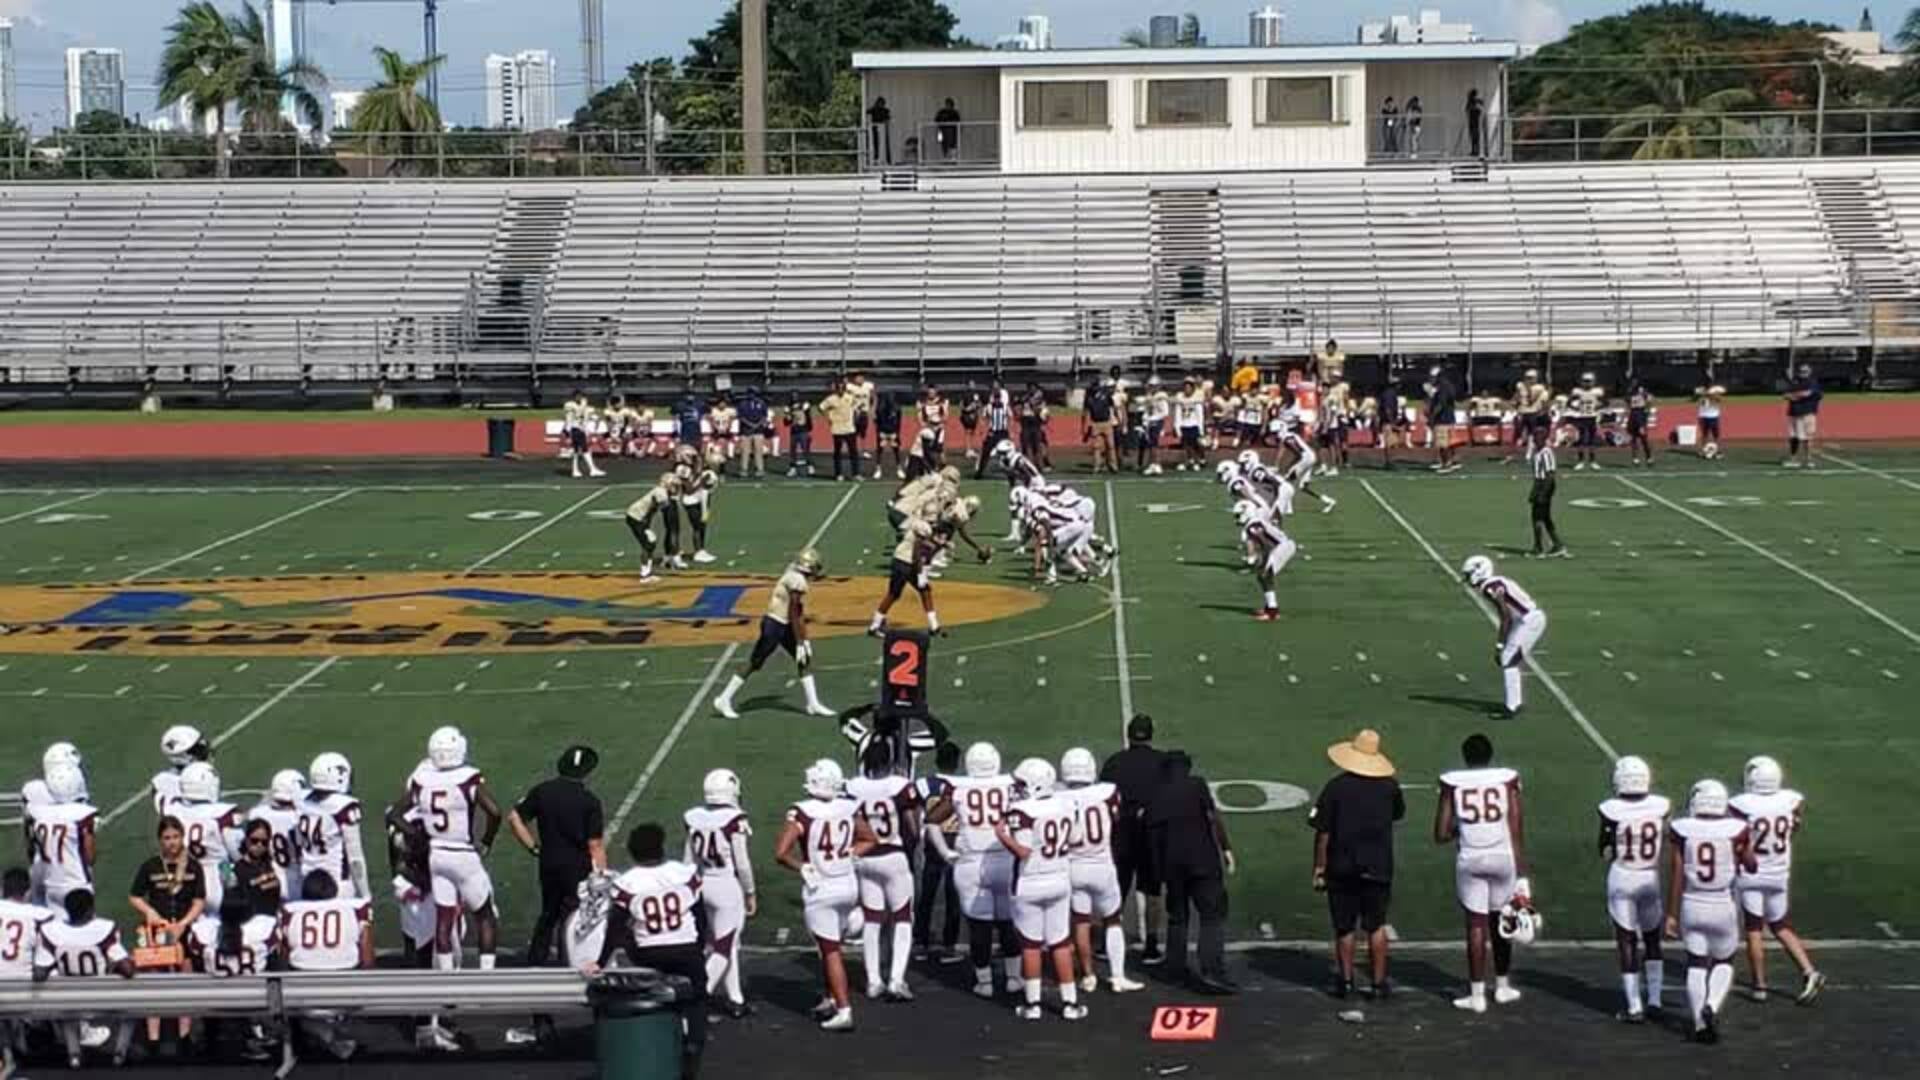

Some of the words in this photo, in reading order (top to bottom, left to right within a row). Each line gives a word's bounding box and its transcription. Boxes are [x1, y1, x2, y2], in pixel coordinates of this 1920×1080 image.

[889, 640, 919, 687] 2
[431, 790, 449, 832] 5
[968, 788, 1003, 826] 99
[1461, 787, 1503, 825] 56
[818, 820, 850, 861] 42
[1041, 816, 1072, 859] 92
[1622, 822, 1658, 861] 18
[1753, 816, 1790, 855] 29
[1696, 842, 1716, 883] 9
[302, 910, 341, 950] 60
[642, 891, 682, 934] 88
[1161, 1008, 1210, 1031] 40
